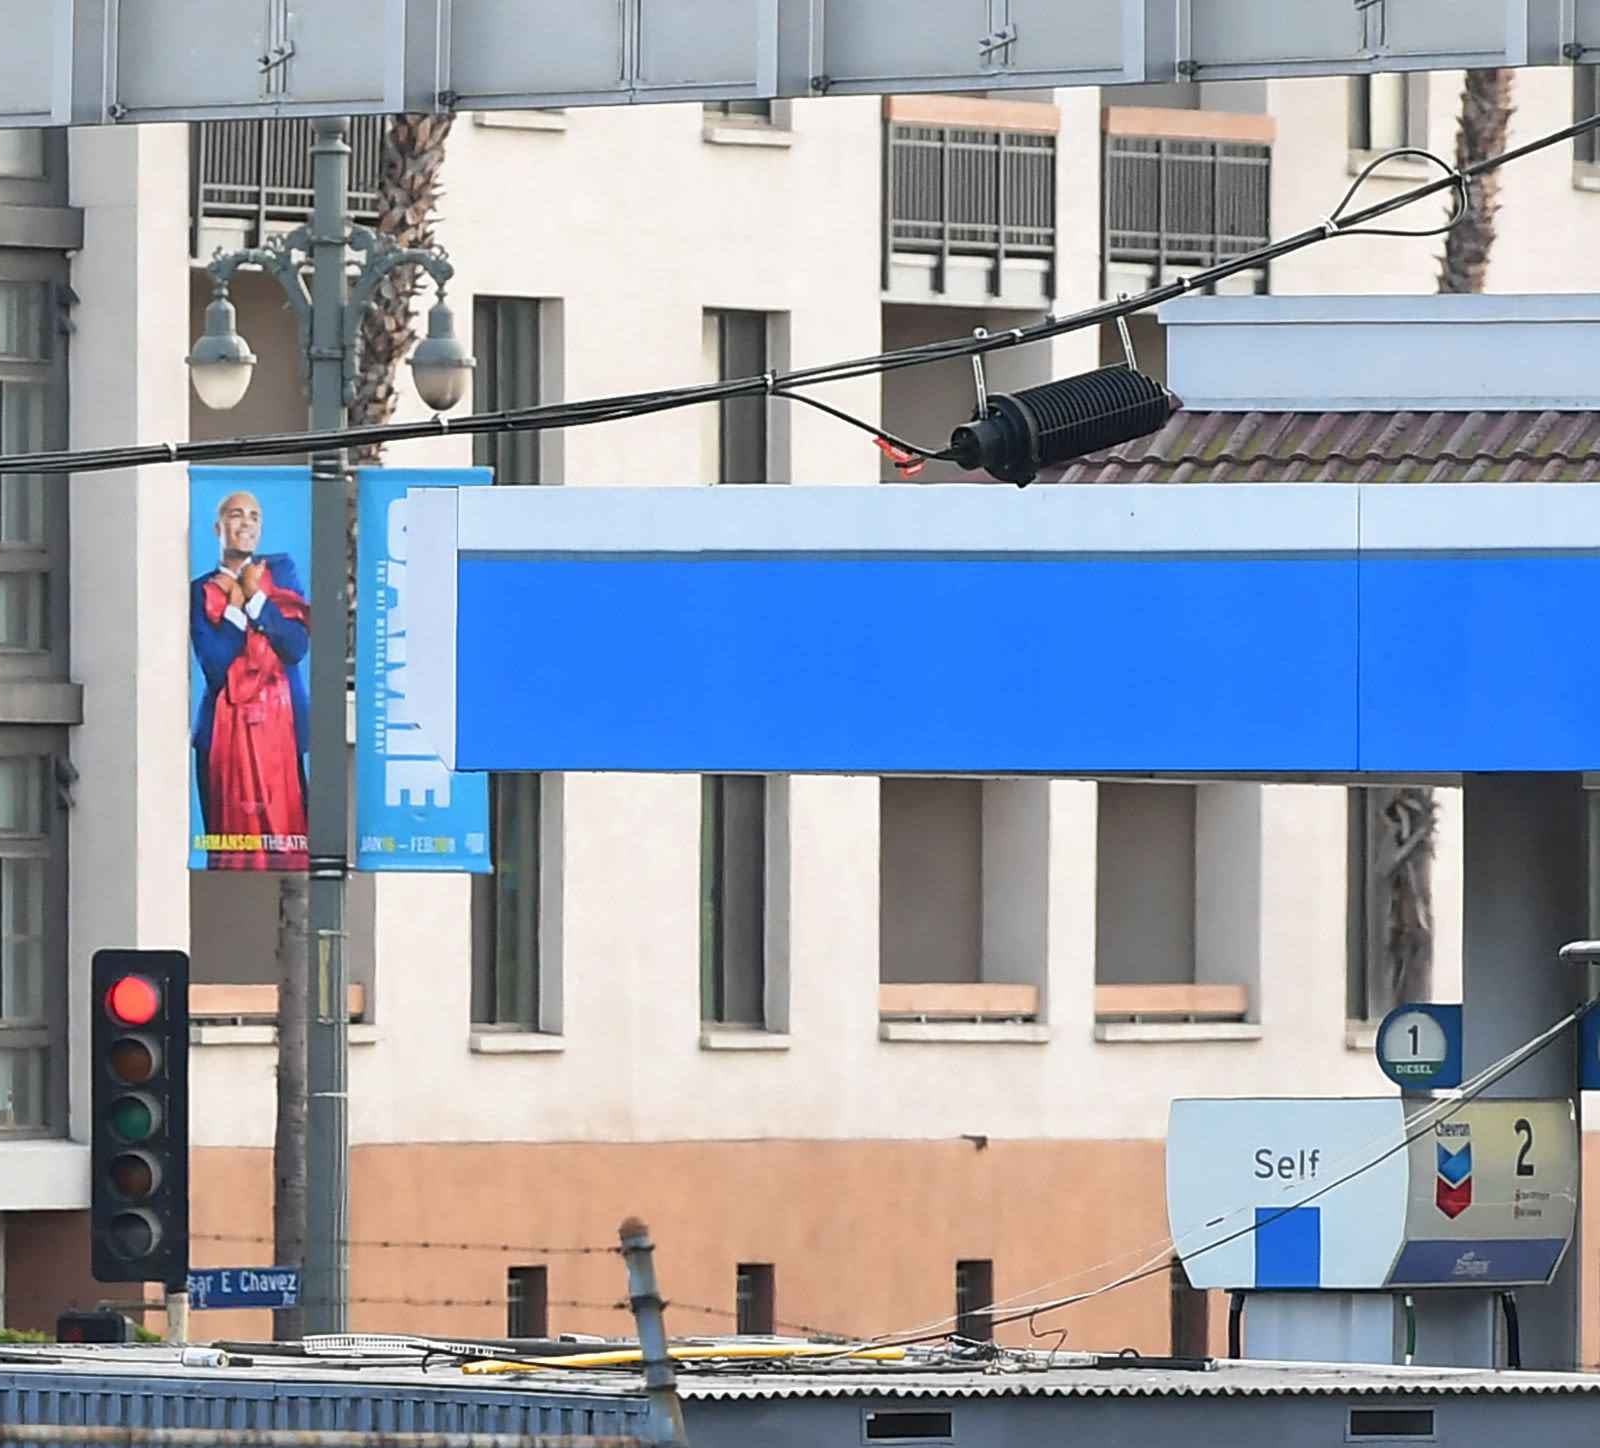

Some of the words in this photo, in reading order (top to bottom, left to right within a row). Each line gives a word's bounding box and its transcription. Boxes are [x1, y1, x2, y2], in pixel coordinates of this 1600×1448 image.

[261, 833, 309, 851] THEATR
[1407, 1024, 1419, 1056] 1
[1396, 1063, 1433, 1074] DIESEL
[1435, 1119, 1471, 1137] Chevron
[1514, 1118, 1535, 1177] 2
[1254, 1148, 1320, 1180] Self
[186, 1275, 214, 1292] sar
[221, 1271, 233, 1293] E
[240, 1270, 297, 1292] Chavez
